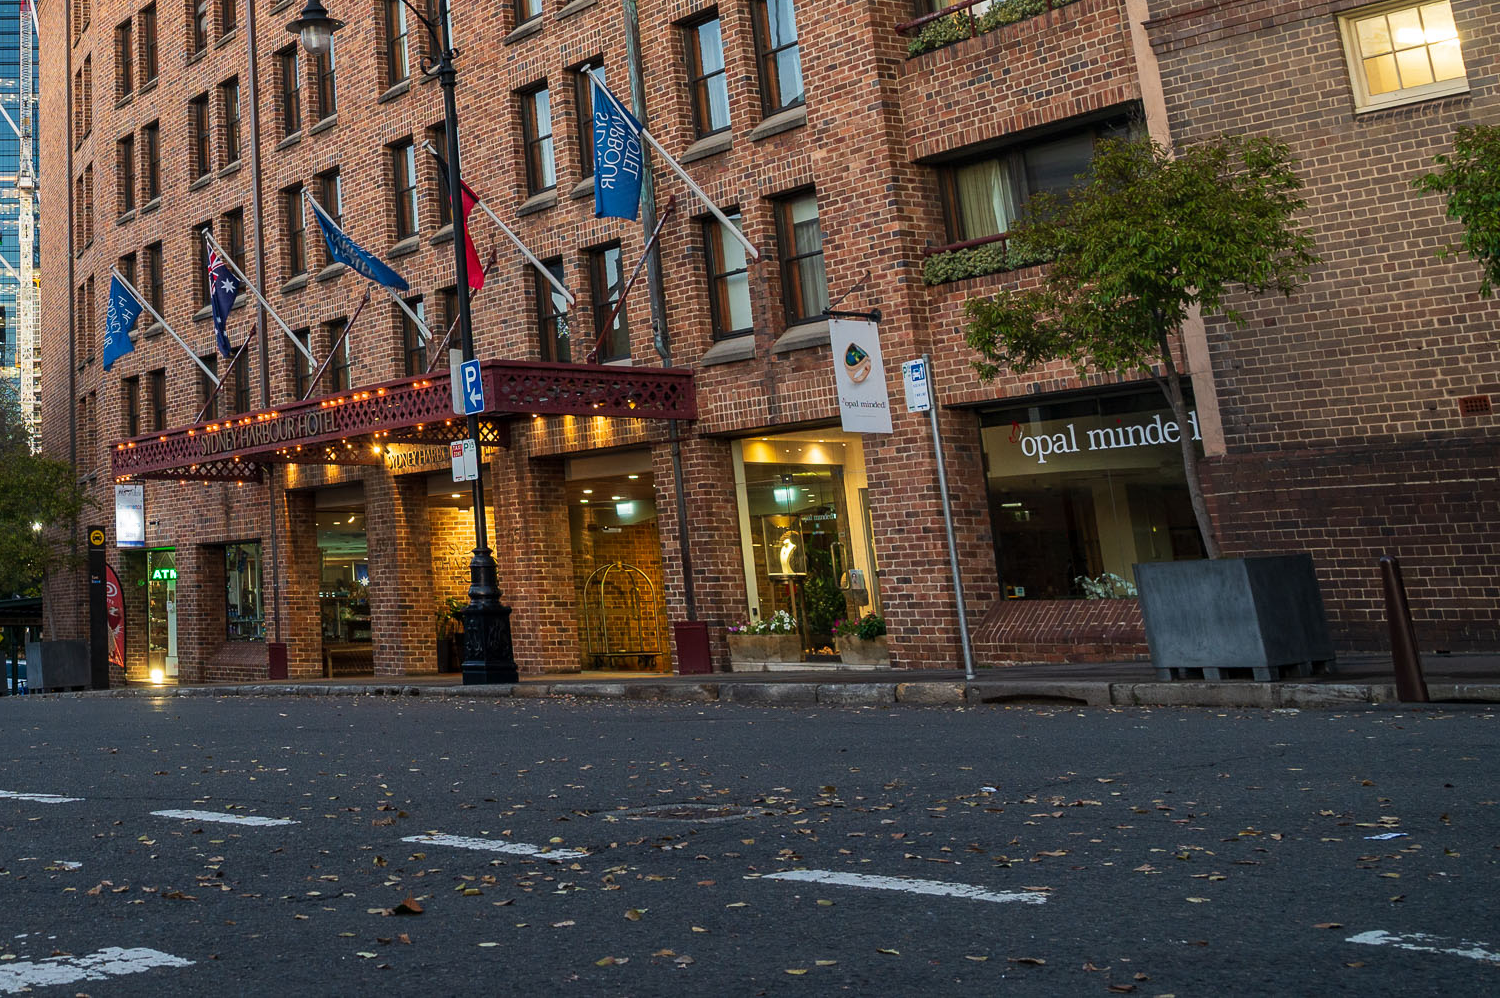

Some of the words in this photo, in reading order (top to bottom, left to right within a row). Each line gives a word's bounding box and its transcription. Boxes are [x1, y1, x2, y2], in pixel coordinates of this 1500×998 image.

[465, 366, 476, 393] P
[844, 400, 859, 409] opal
[860, 400, 886, 409] minded
[201, 430, 237, 455] SYDNEY
[240, 418, 295, 447] HARBOUR
[299, 410, 339, 436] HOTEL
[1021, 423, 1080, 464] opal
[389, 451, 416, 470] SYDNEY
[417, 445, 452, 466] HARBO
